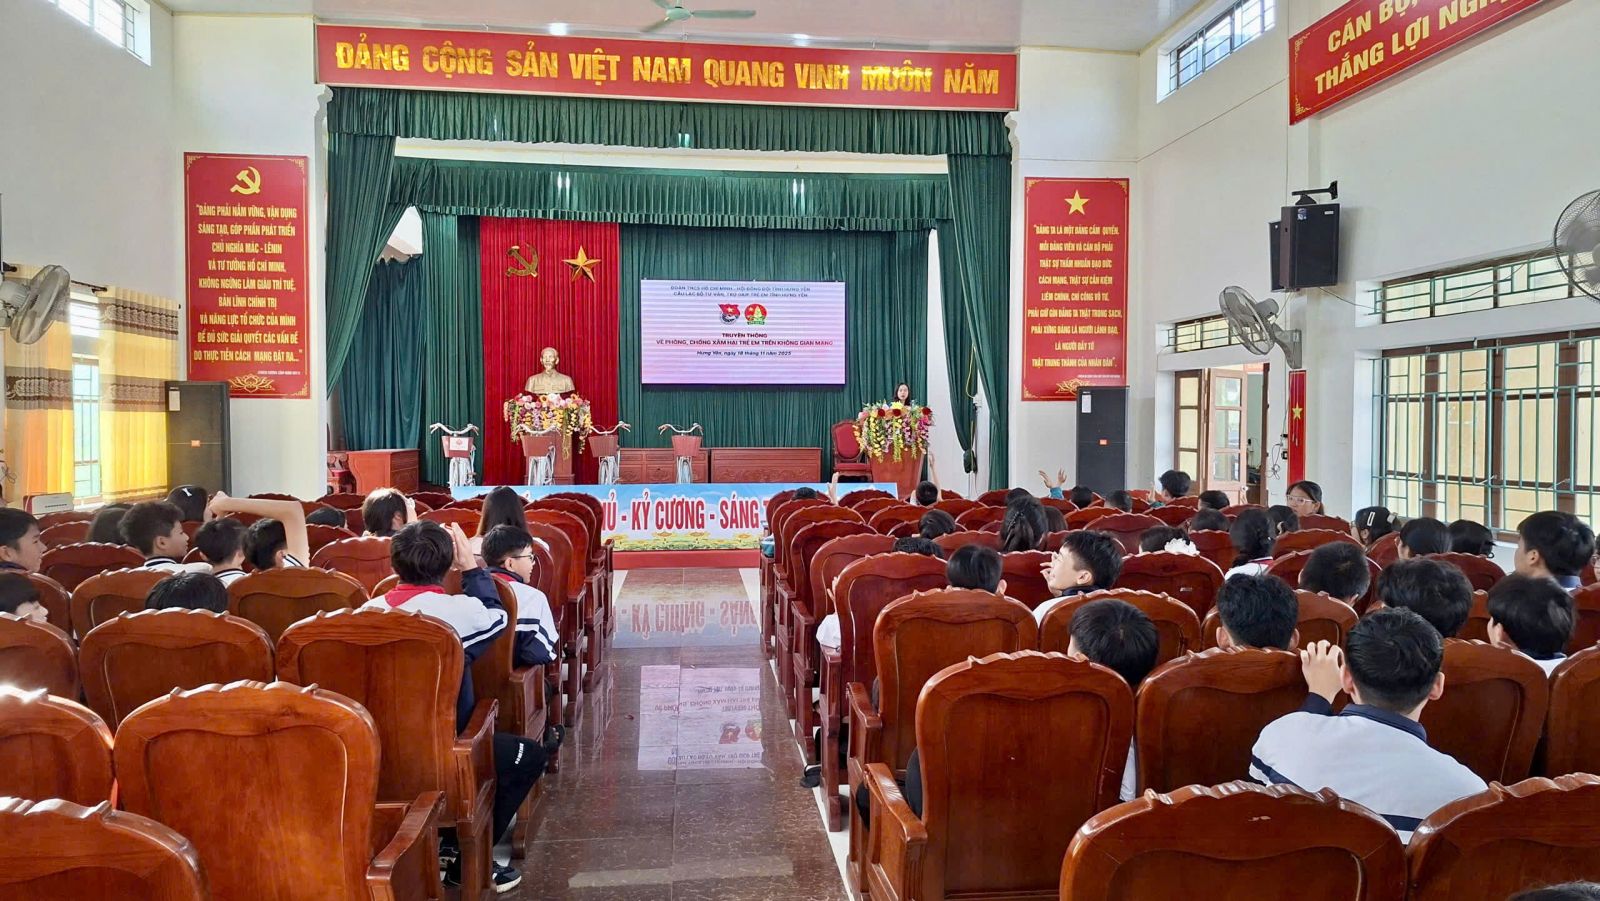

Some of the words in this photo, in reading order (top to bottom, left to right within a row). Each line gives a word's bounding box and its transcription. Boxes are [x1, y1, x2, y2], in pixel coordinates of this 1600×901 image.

[1328, 17, 1372, 52] CÁN
[1315, 42, 1384, 94] THẮNG
[1391, 15, 1430, 55] LỢI
[335, 33, 410, 71] ĐẢNG
[422, 41, 493, 79] CỘNG
[505, 41, 558, 78] SẢN
[569, 48, 620, 86] VIỆT
[632, 56, 692, 83] NAM
[703, 58, 785, 88] QUANG
[795, 62, 849, 90] VINH
[862, 59, 933, 92] MUÔN
[944, 62, 999, 94] NĂM
[217, 202, 231, 216] PHẢI
[267, 206, 279, 220] VẬN
[280, 208, 297, 220] DỤNG
[198, 221, 214, 234] SÁNG
[230, 223, 242, 235] GÓP
[262, 224, 277, 235] PHÁT
[212, 239, 224, 253] CHỦ
[226, 241, 244, 253] NGHĨA
[245, 241, 259, 253] MÁC
[265, 242, 282, 254] LÊNIN
[208, 259, 216, 270] VÀ
[218, 260, 225, 270] TƯ
[257, 261, 267, 272] CHÍ
[199, 276, 219, 288] KHÔNG
[243, 277, 256, 289] LÀM
[273, 278, 282, 290] TRÍ
[219, 294, 231, 307] BẢN
[248, 295, 266, 307] CHÍNH
[267, 298, 277, 310] TRỊ
[200, 312, 208, 325] VÀ
[209, 313, 226, 325] NĂNG
[266, 312, 278, 325] CỦA
[280, 313, 296, 326] MÌNH
[264, 331, 275, 343] CÁC
[235, 348, 251, 361] CÁCH
[632, 492, 650, 530] KỶ
[655, 498, 705, 530] CƯƠNG
[720, 493, 759, 529] SÁNG
